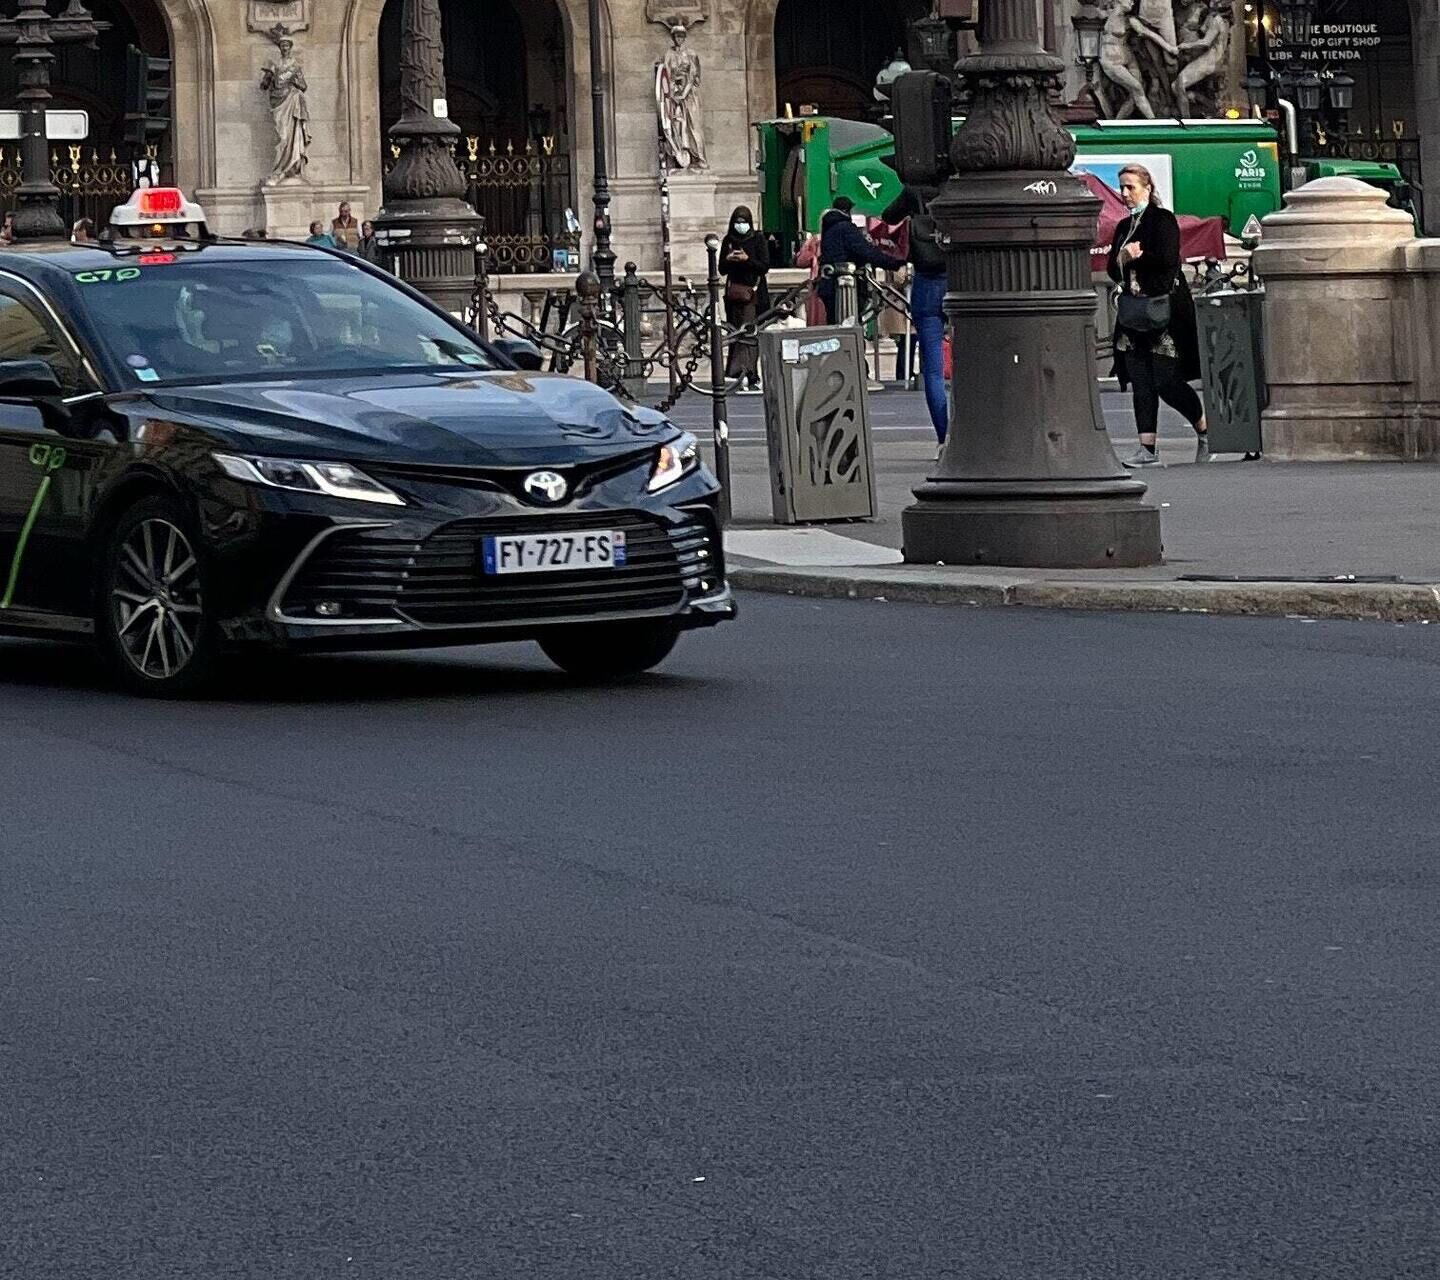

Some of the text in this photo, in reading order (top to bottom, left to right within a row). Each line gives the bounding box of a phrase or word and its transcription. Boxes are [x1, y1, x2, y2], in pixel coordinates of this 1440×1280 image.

[1324, 24, 1378, 34] BOUTIQUE
[1327, 37, 1350, 47] GIFT
[1352, 37, 1381, 46] SHOP
[1322, 50, 1361, 60] TIENDA
[1235, 168, 1266, 177] PARIS
[501, 535, 610, 567] FY-727-FS
